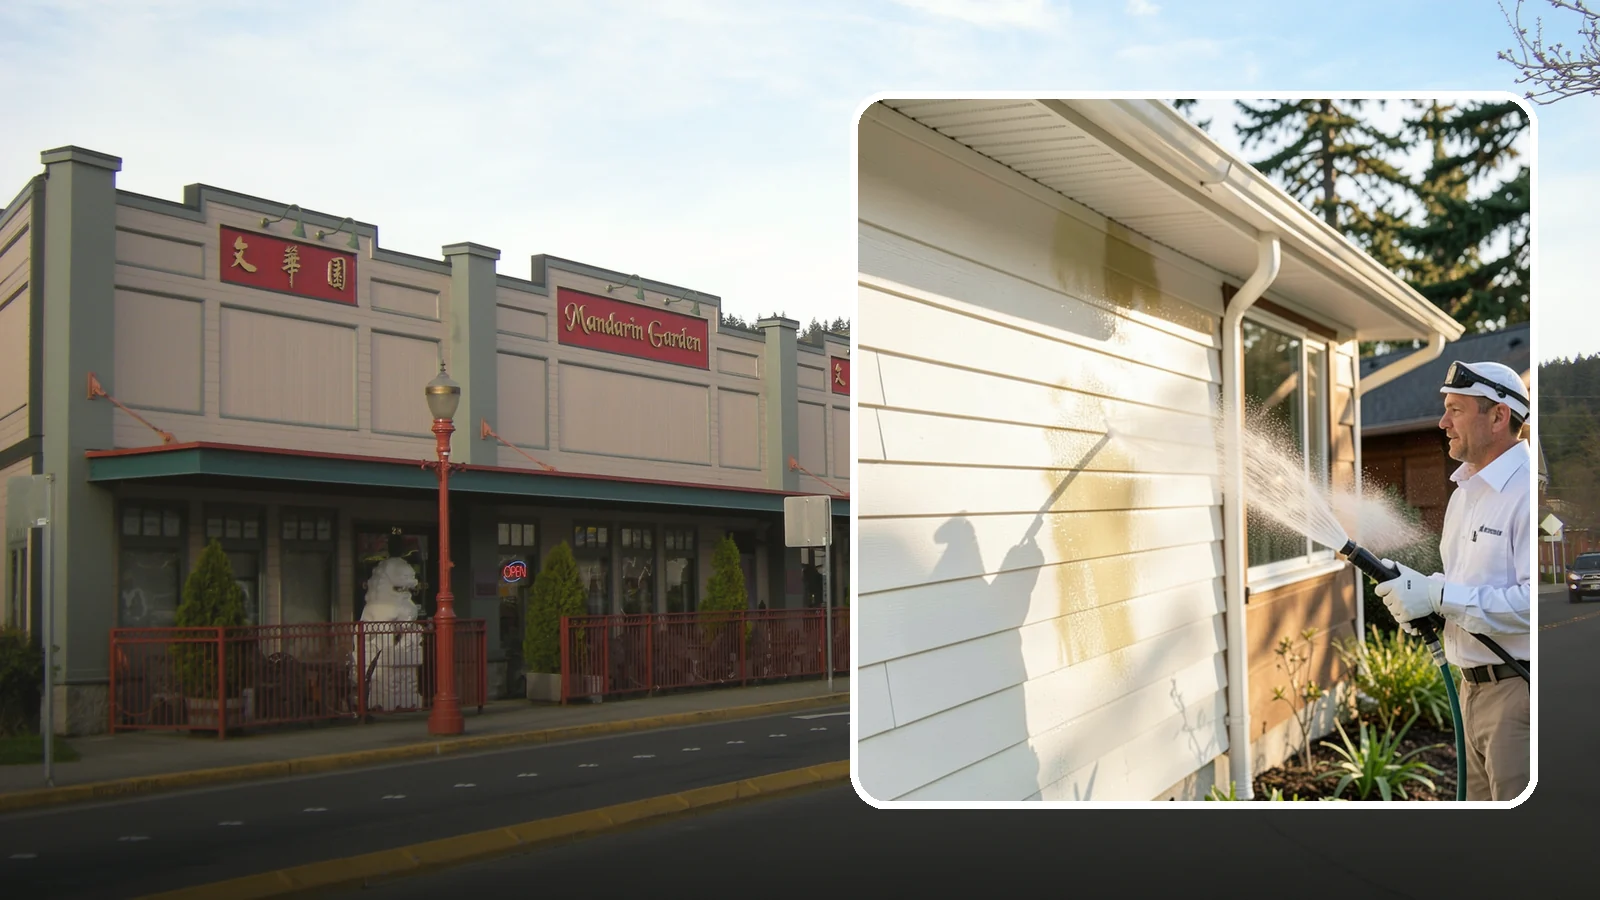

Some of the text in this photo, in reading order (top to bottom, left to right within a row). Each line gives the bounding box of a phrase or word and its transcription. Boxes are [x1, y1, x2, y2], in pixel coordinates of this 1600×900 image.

[230, 235, 347, 291] 文華園
[564, 302, 702, 352] Mandarin Garden
[503, 565, 527, 578] OPEN
